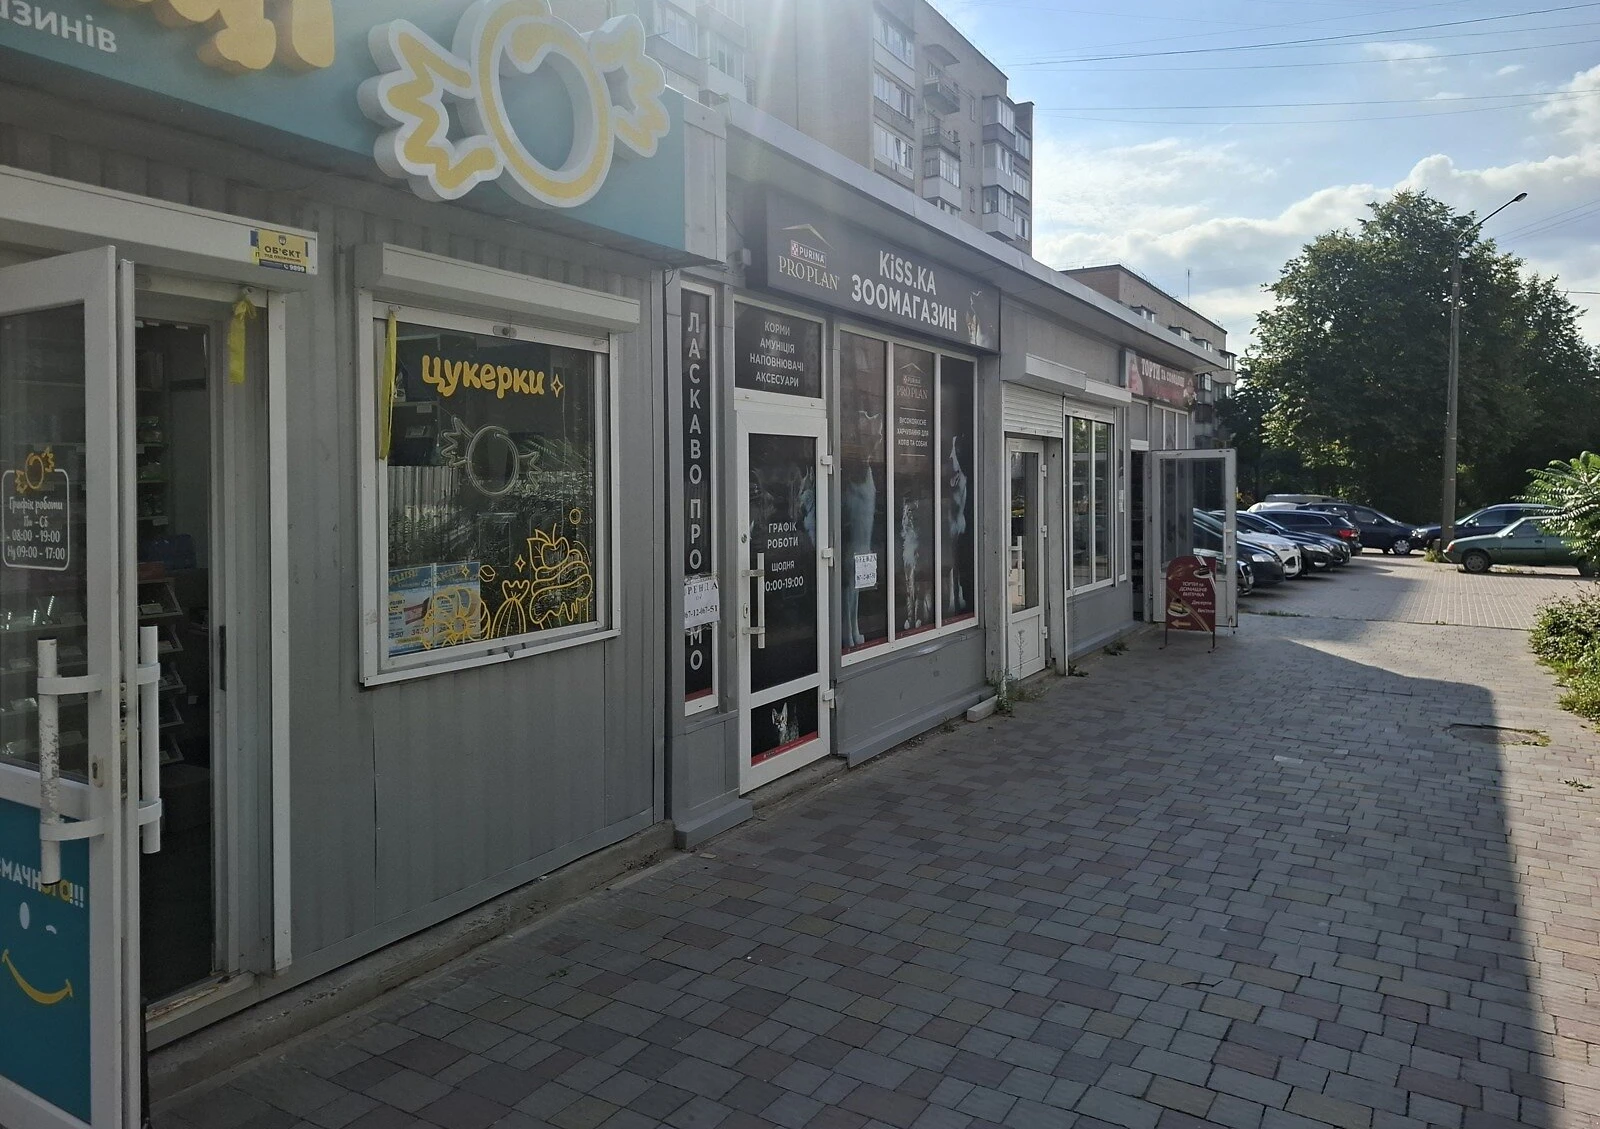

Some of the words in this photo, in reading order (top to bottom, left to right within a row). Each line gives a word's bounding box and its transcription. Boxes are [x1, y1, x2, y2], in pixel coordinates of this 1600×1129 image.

[264, 245, 301, 259] ОБ'ЄКТ
[799, 246, 825, 264] PURINA
[779, 255, 804, 280] PRO
[807, 263, 839, 290] PLAN
[851, 275, 957, 332] ЗООМАГАЗИН
[764, 321, 791, 337] КОРМИ
[760, 338, 795, 354] АМУНІЦІЯ
[750, 353, 804, 372] НАПОВНЮВАЧІ
[755, 371, 799, 388] АКСЕСУАРИ
[687, 312, 702, 485] ЛАСКАВО
[768, 522, 797, 534] ГРАФІК
[767, 537, 799, 549] РОБОТИ
[16, 545, 38, 558] 09:00
[45, 546, 65, 560] 17:00
[771, 560, 795, 573] ЩОДНЯ
[685, 582, 718, 595] РЕНДА
[689, 499, 703, 671] ПРОМО
[764, 576, 804, 592] 0:00-19:00
